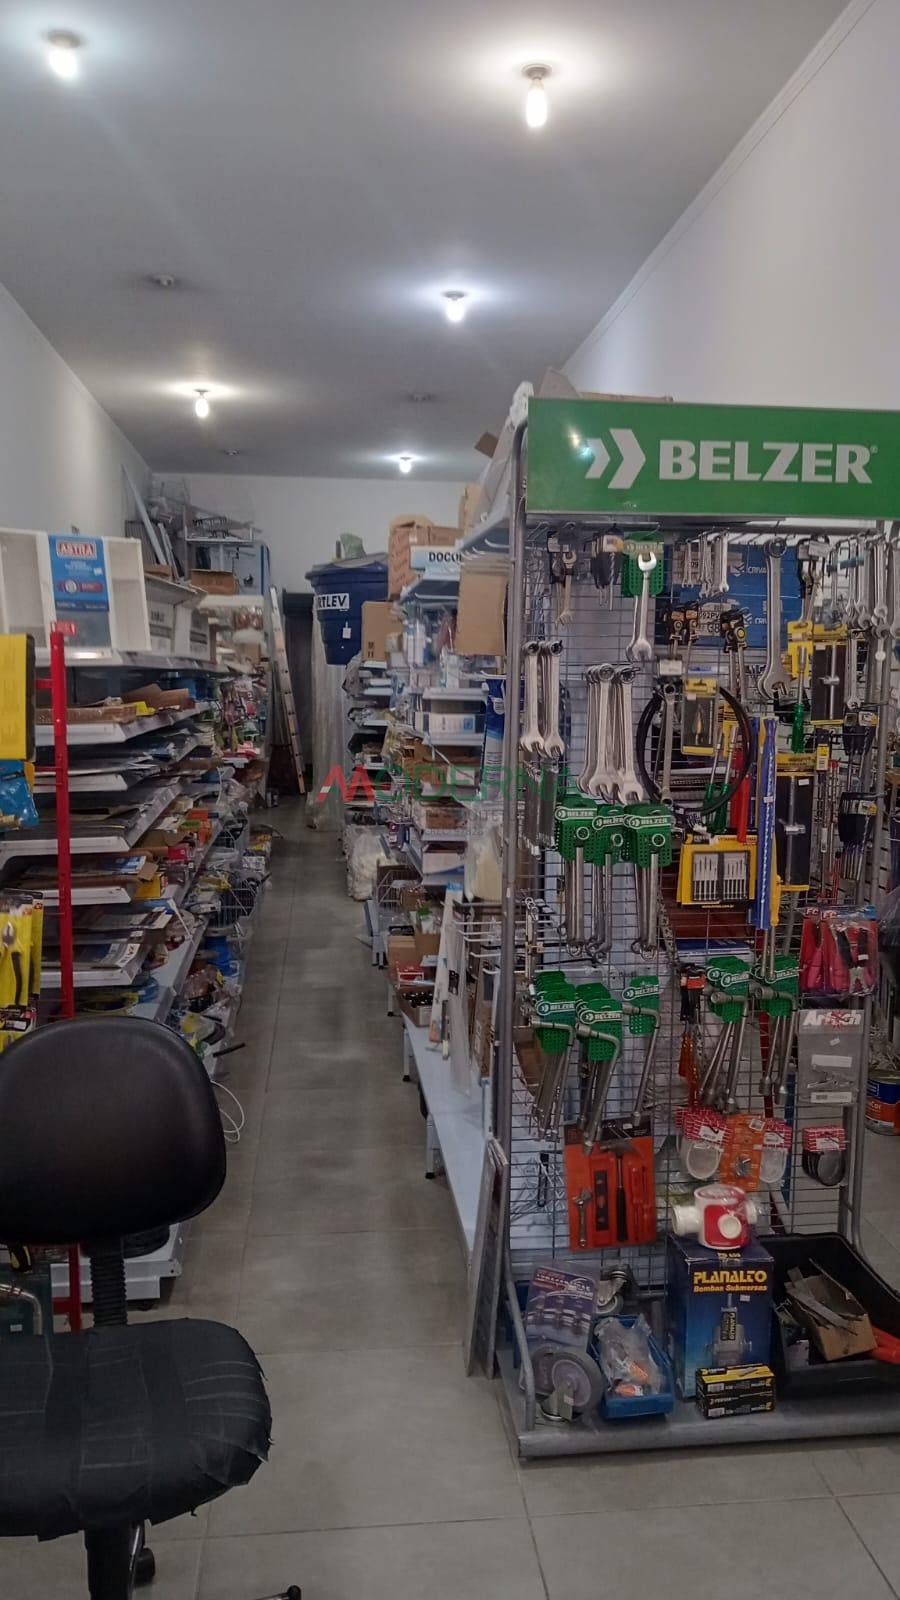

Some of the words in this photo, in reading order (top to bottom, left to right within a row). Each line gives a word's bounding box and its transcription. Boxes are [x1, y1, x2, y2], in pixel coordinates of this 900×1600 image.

[659, 439, 873, 484] BELZER
[640, 817, 668, 825] BELZER
[693, 1270, 768, 1284] PLANALTO
